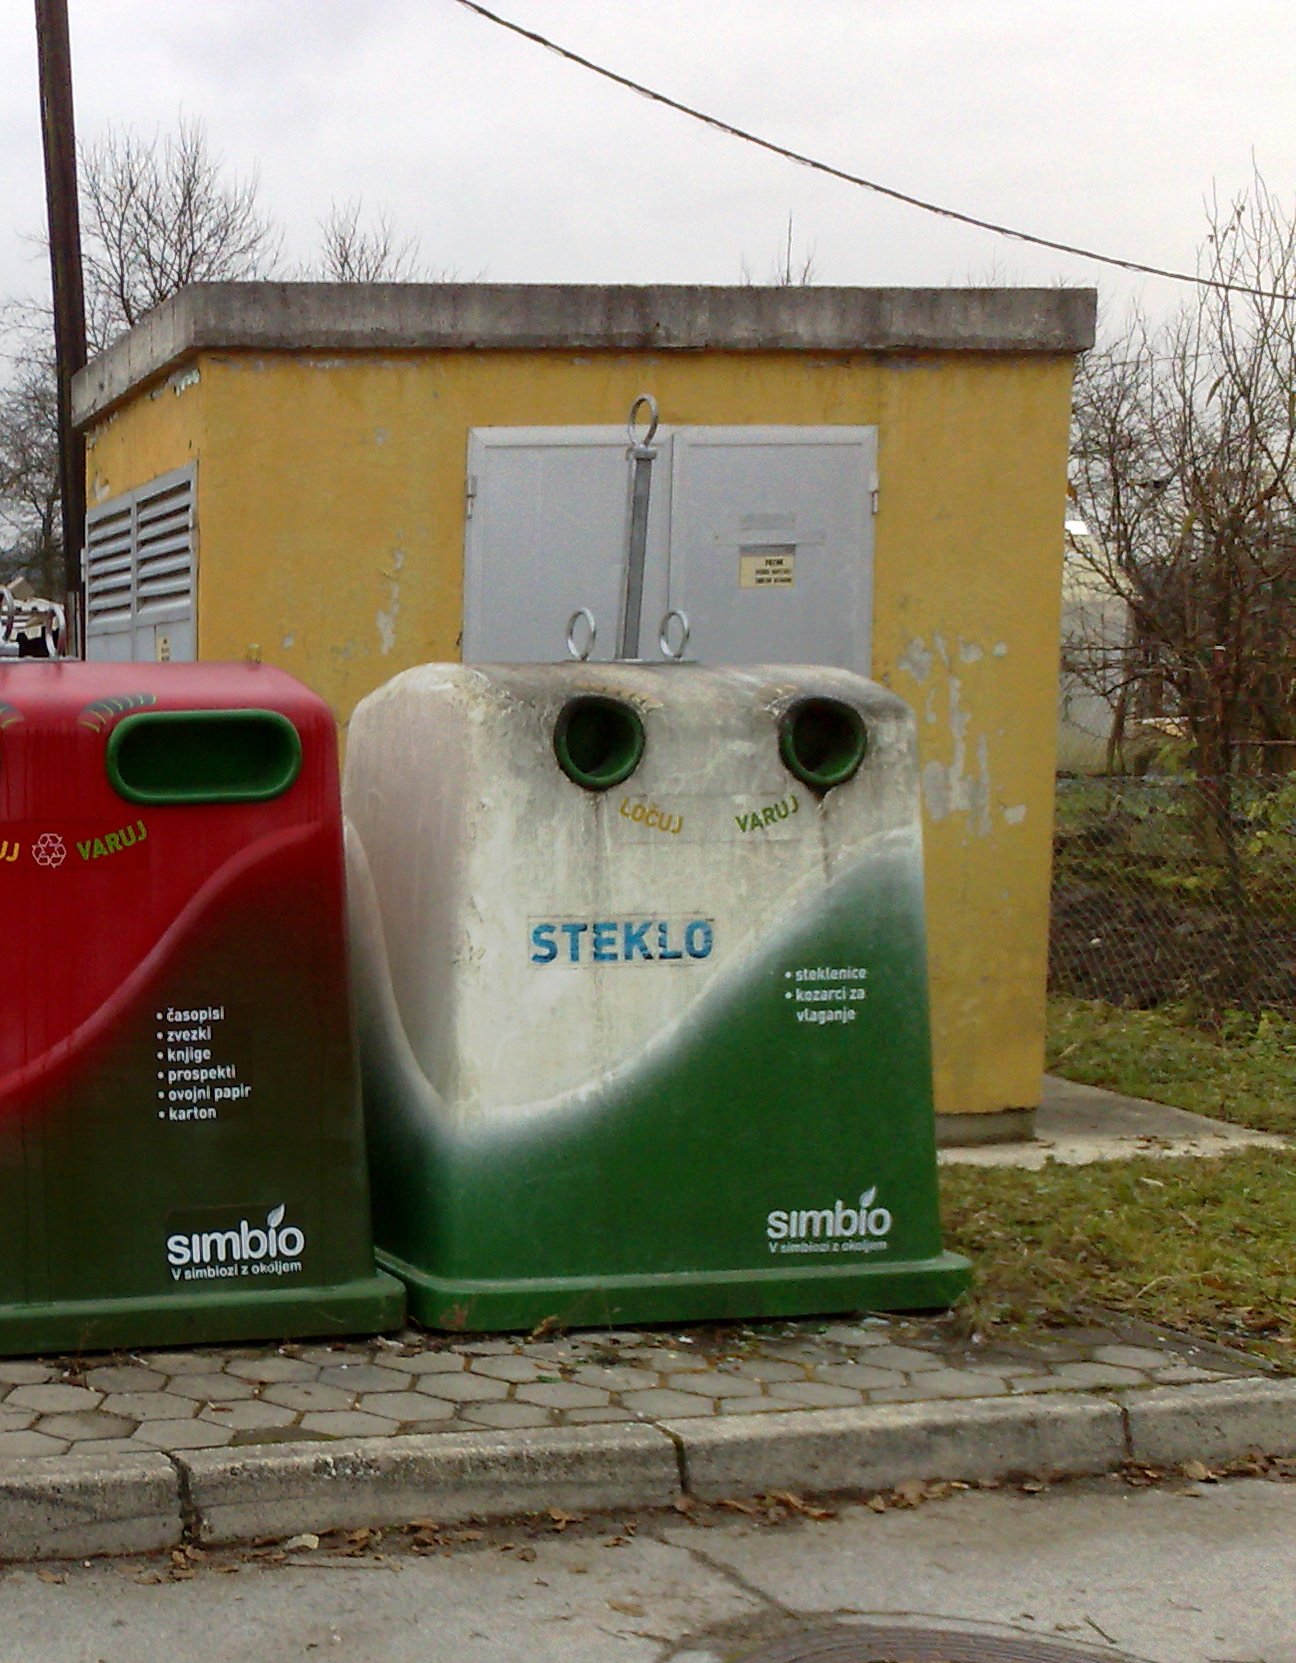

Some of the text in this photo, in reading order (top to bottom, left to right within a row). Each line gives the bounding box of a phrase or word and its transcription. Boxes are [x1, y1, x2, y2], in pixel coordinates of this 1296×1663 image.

[619, 795, 800, 834] LOČUJ VARUJ
[76, 820, 148, 861] VARUJ
[531, 920, 714, 964] STEKLO
[795, 966, 867, 982] steklenice
[796, 987, 866, 1001] kozarci za
[166, 1006, 225, 1024] časopisi
[796, 1007, 856, 1024] vlaganje
[166, 1026, 212, 1043] zvezki
[167, 1046, 212, 1064] knjige
[167, 1064, 236, 1085] prospekti
[168, 1083, 252, 1103] ovojni papir
[168, 1106, 217, 1121] karton
[767, 1186, 892, 1239] simbio
[167, 1204, 305, 1266] simbio
[769, 1241, 779, 1253] V
[171, 1261, 303, 1281] V simbiozi z okoljem
